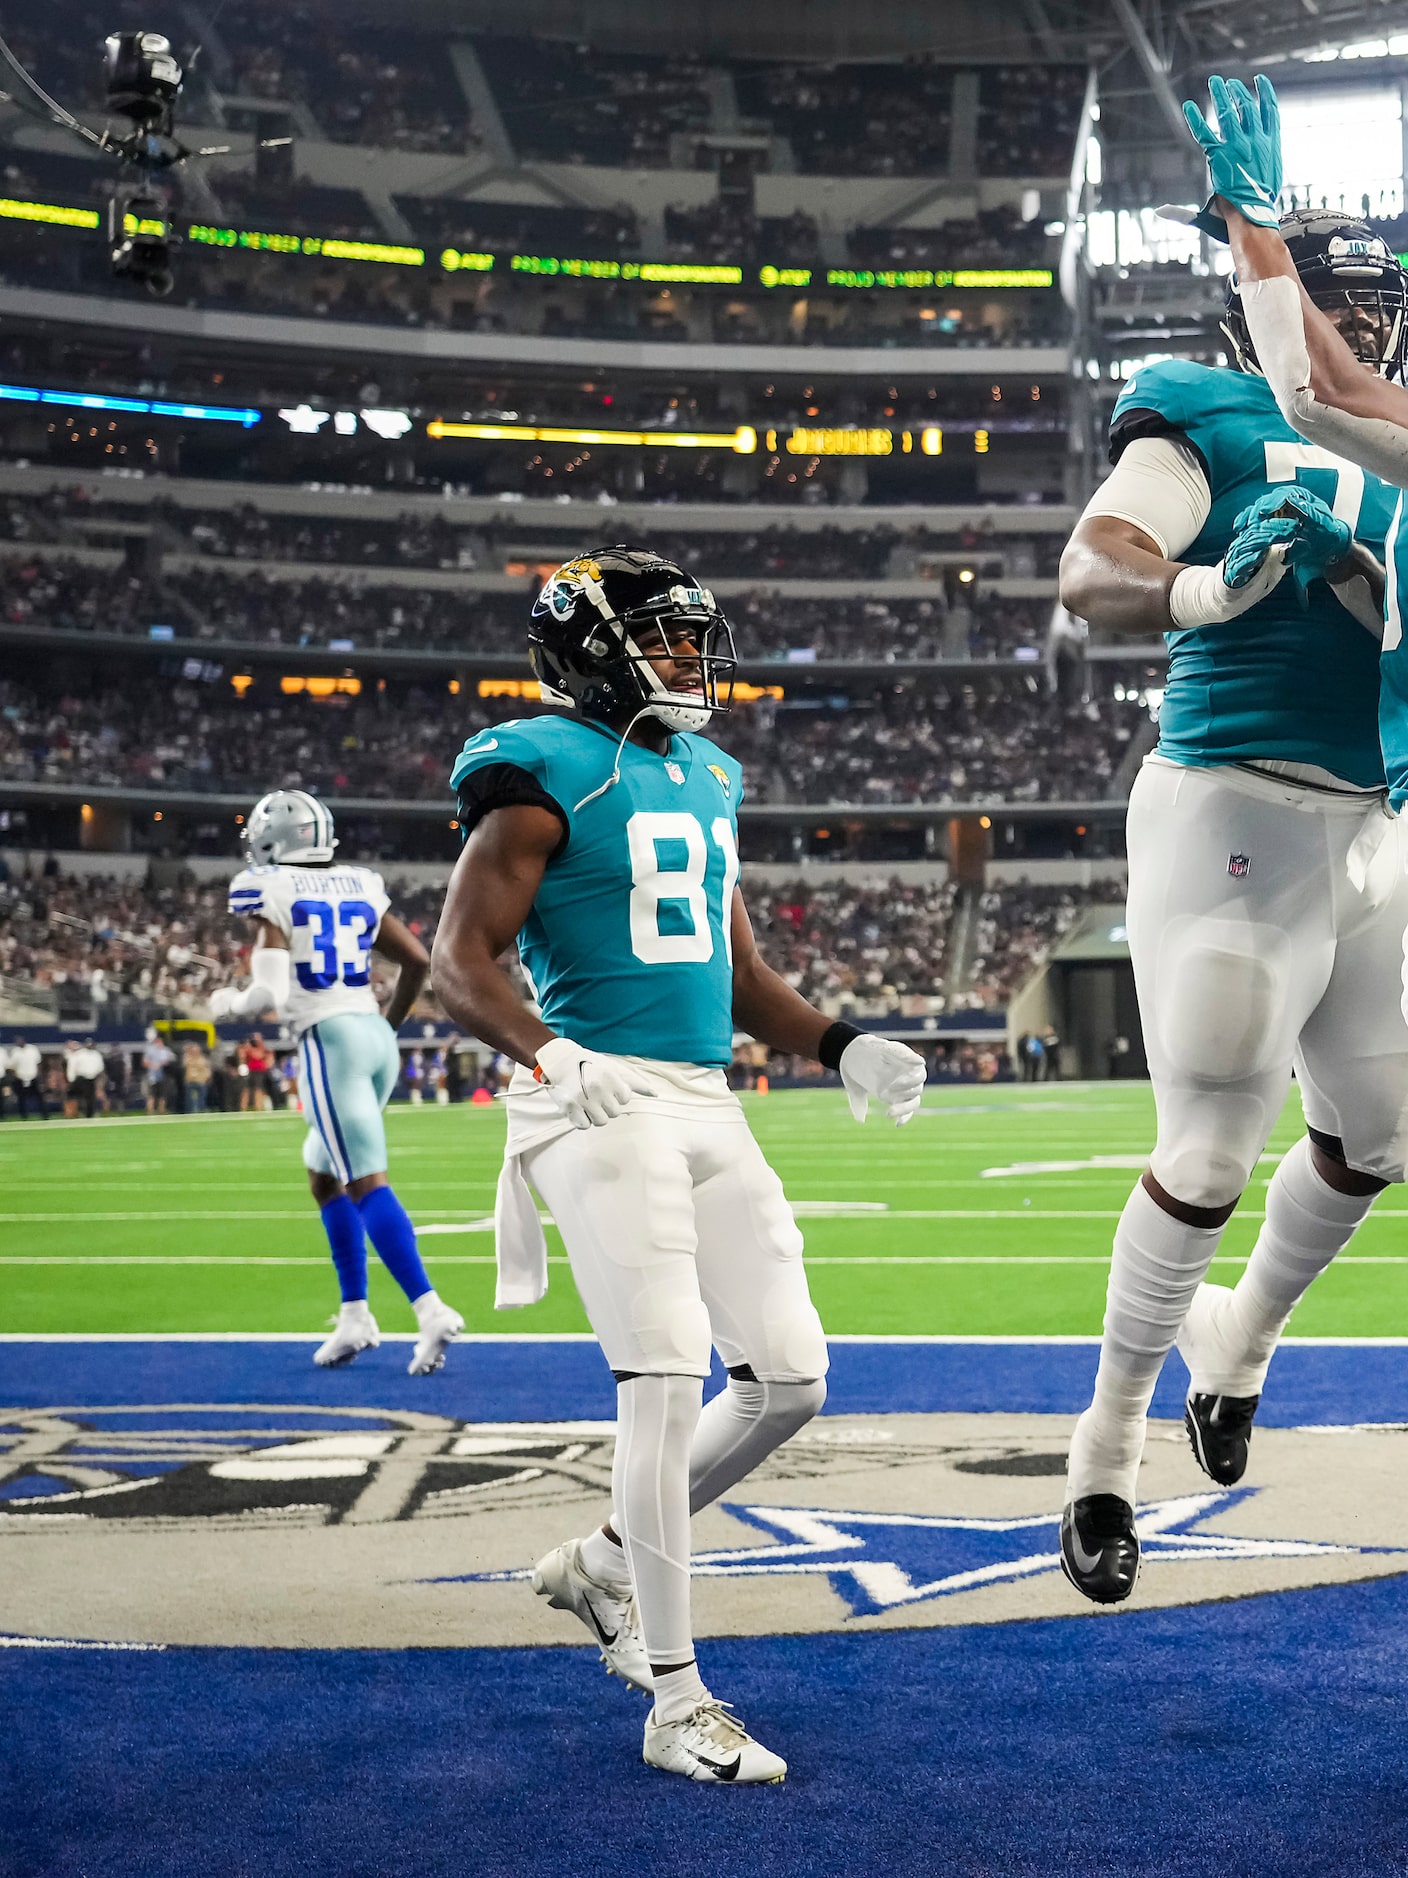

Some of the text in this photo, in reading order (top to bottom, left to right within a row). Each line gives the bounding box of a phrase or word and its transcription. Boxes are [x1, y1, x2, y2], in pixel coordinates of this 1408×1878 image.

[291, 873, 365, 894] BURTON
[626, 812, 738, 967] 81
[291, 900, 378, 991] 33
